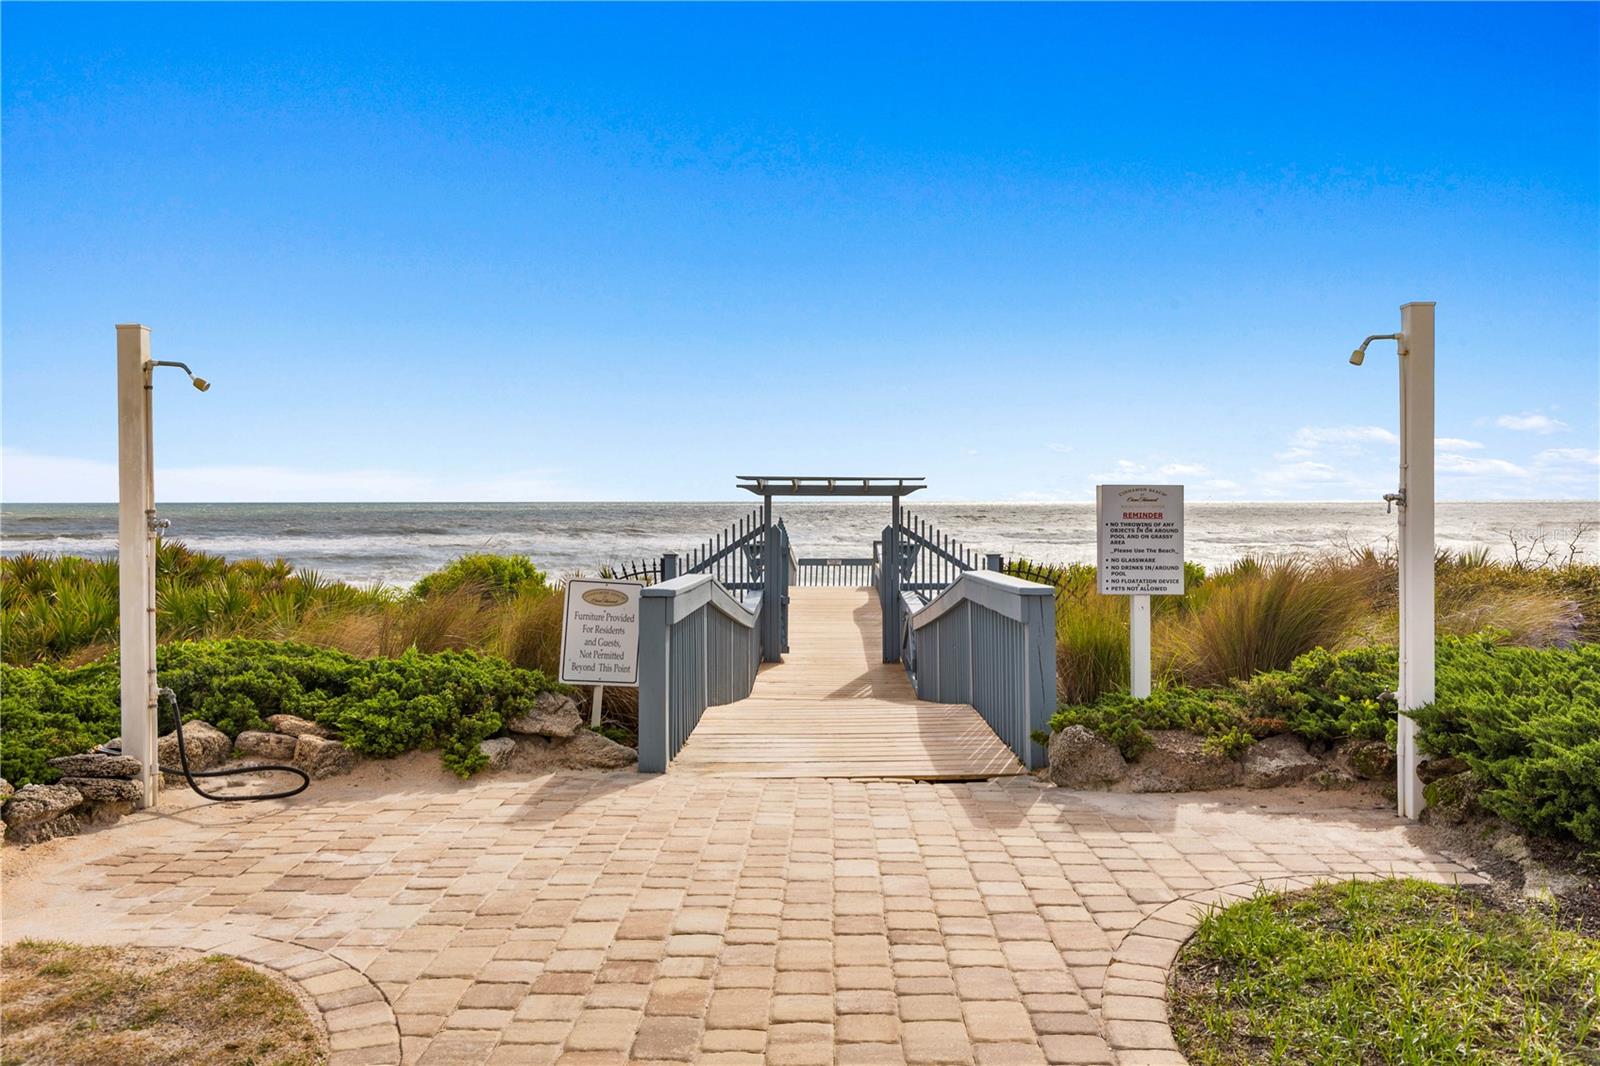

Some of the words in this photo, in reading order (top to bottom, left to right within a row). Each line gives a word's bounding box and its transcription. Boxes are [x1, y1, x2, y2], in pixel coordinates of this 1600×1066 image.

[574, 611, 605, 621] Furniture
[606, 613, 635, 622] Provided
[583, 624, 592, 633] For
[595, 625, 625, 634] Residents
[584, 638, 596, 646] and
[598, 638, 621, 648] Guests,
[579, 650, 592, 658] Not
[593, 651, 624, 660] Permitted
[572, 662, 595, 673] Beyond
[599, 664, 612, 672] This
[614, 664, 630, 672] Point
